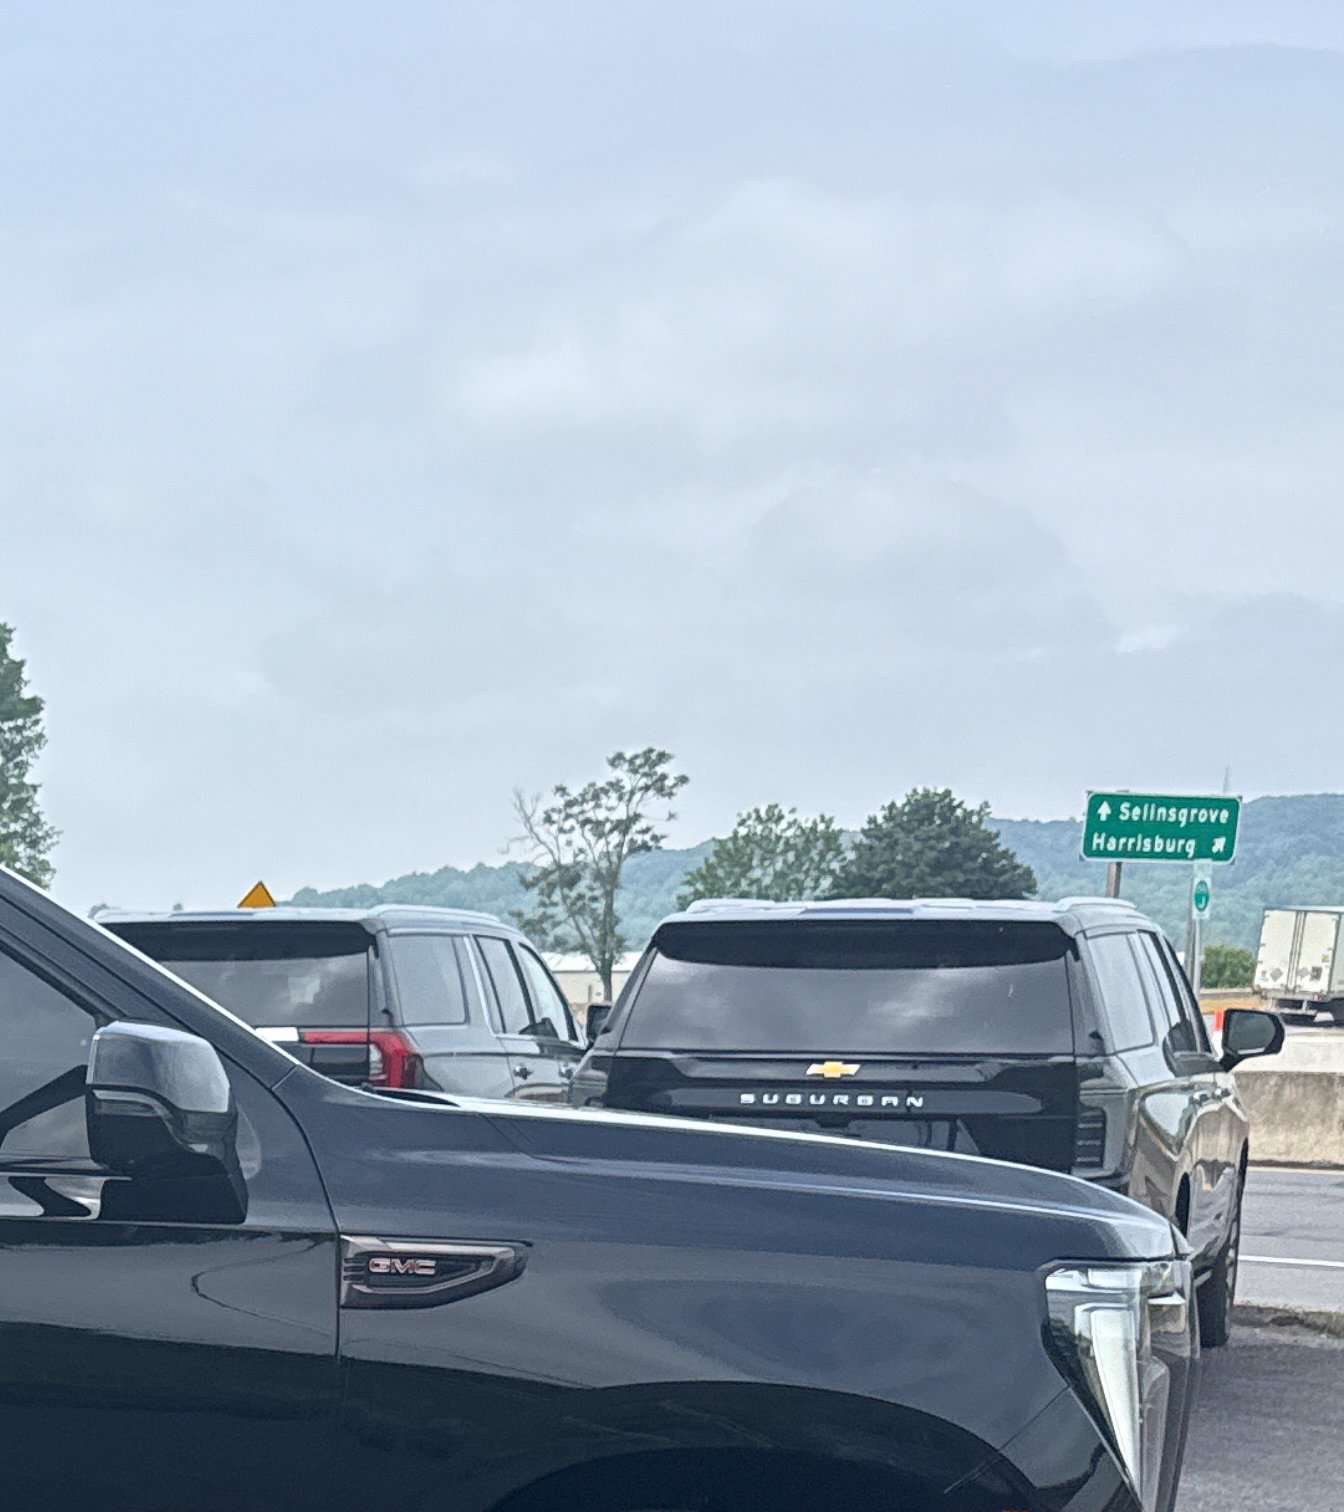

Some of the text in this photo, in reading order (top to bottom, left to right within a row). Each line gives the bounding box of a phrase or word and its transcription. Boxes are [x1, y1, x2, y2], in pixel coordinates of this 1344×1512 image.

[1119, 801, 1229, 827] Selinsgrove
[1092, 832, 1196, 858] Harrisburg
[740, 1093, 923, 1107] SUBURBAN
[368, 1257, 436, 1275] GMC
